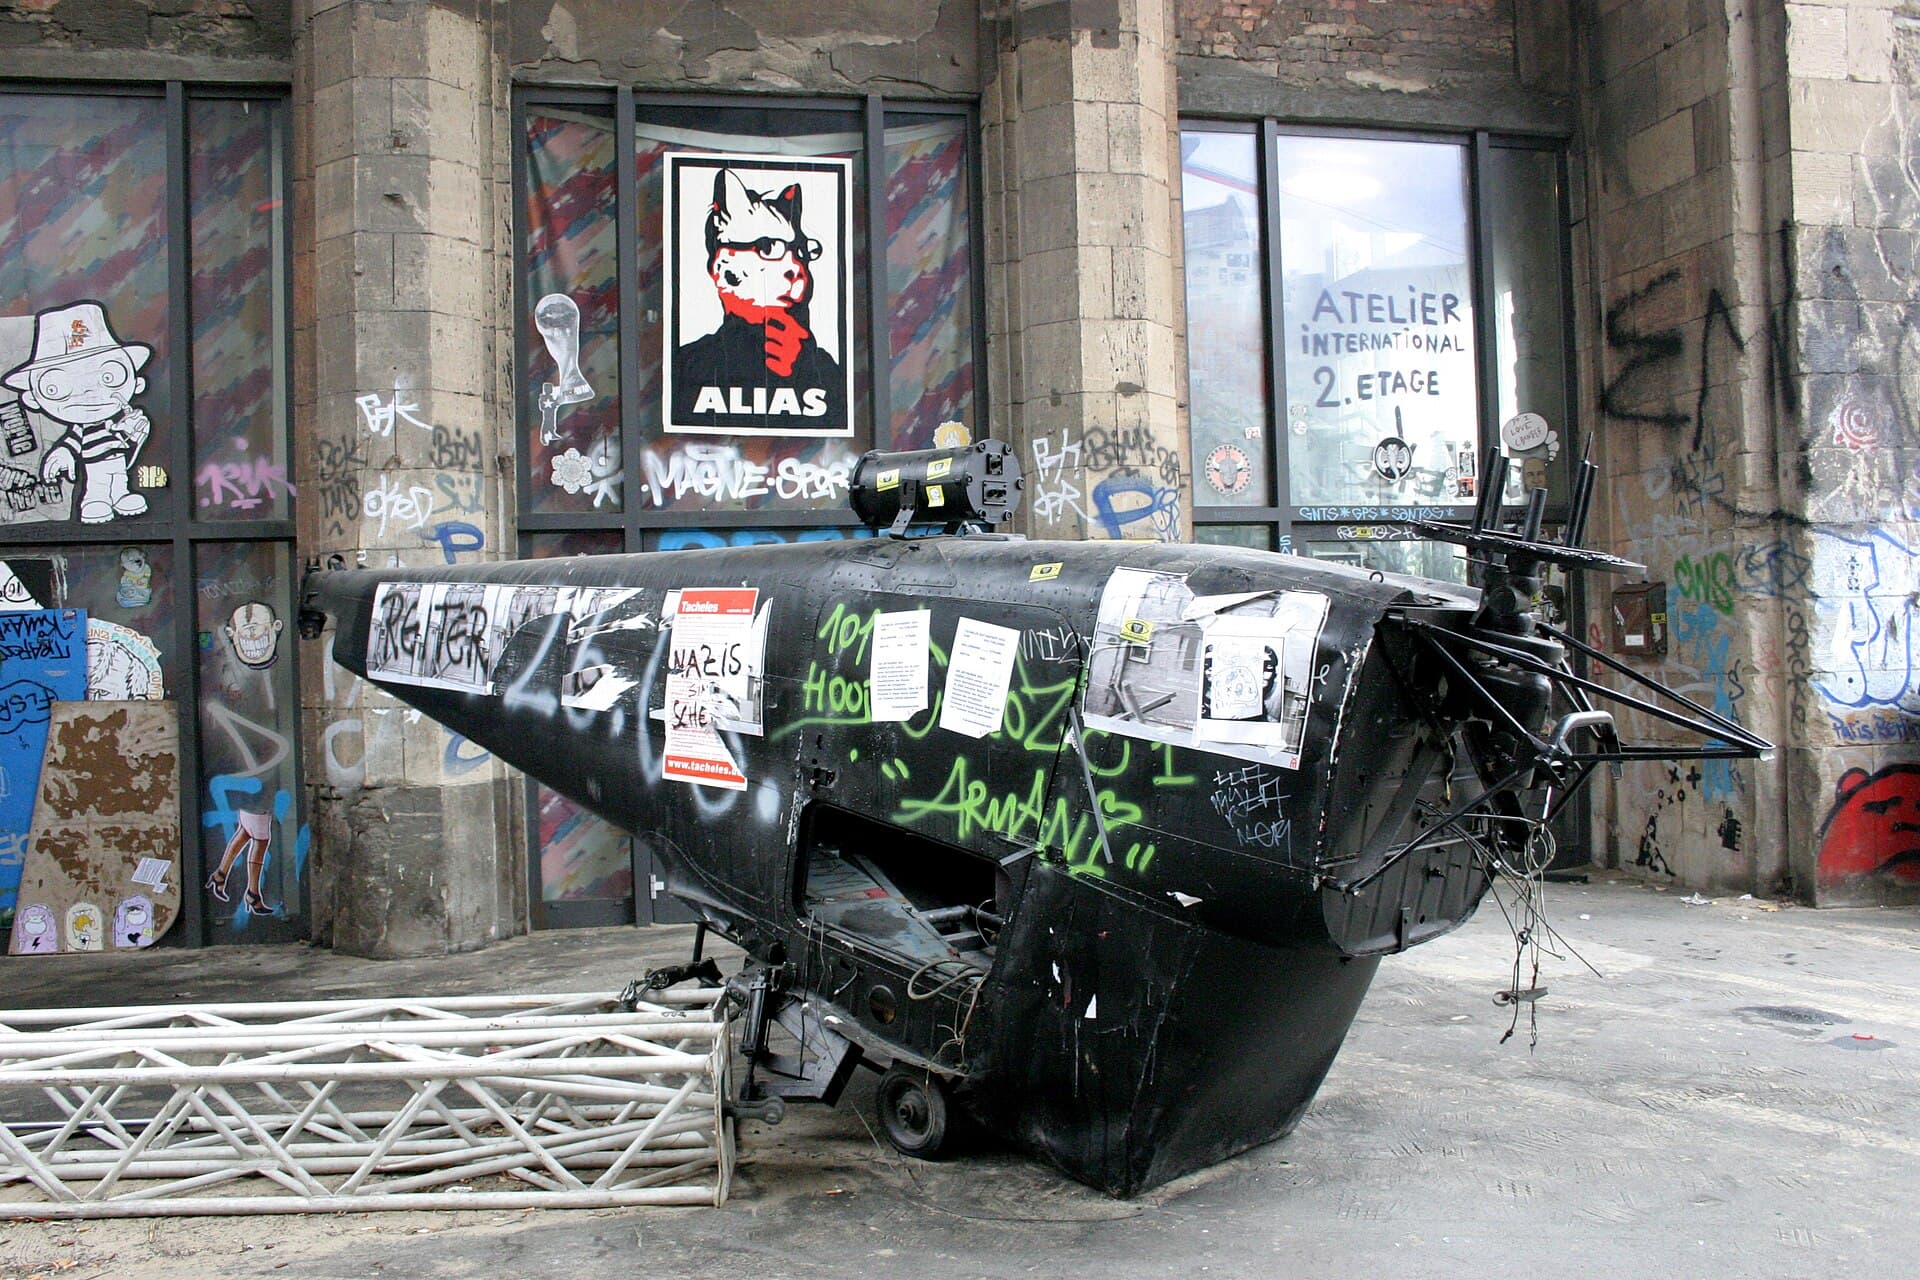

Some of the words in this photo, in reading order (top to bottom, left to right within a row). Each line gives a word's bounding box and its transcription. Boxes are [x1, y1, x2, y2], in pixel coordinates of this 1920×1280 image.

[1356, 370, 1441, 401] ETAGE
[692, 386, 828, 417] ALIAS
[681, 600, 719, 614] Tacheles
